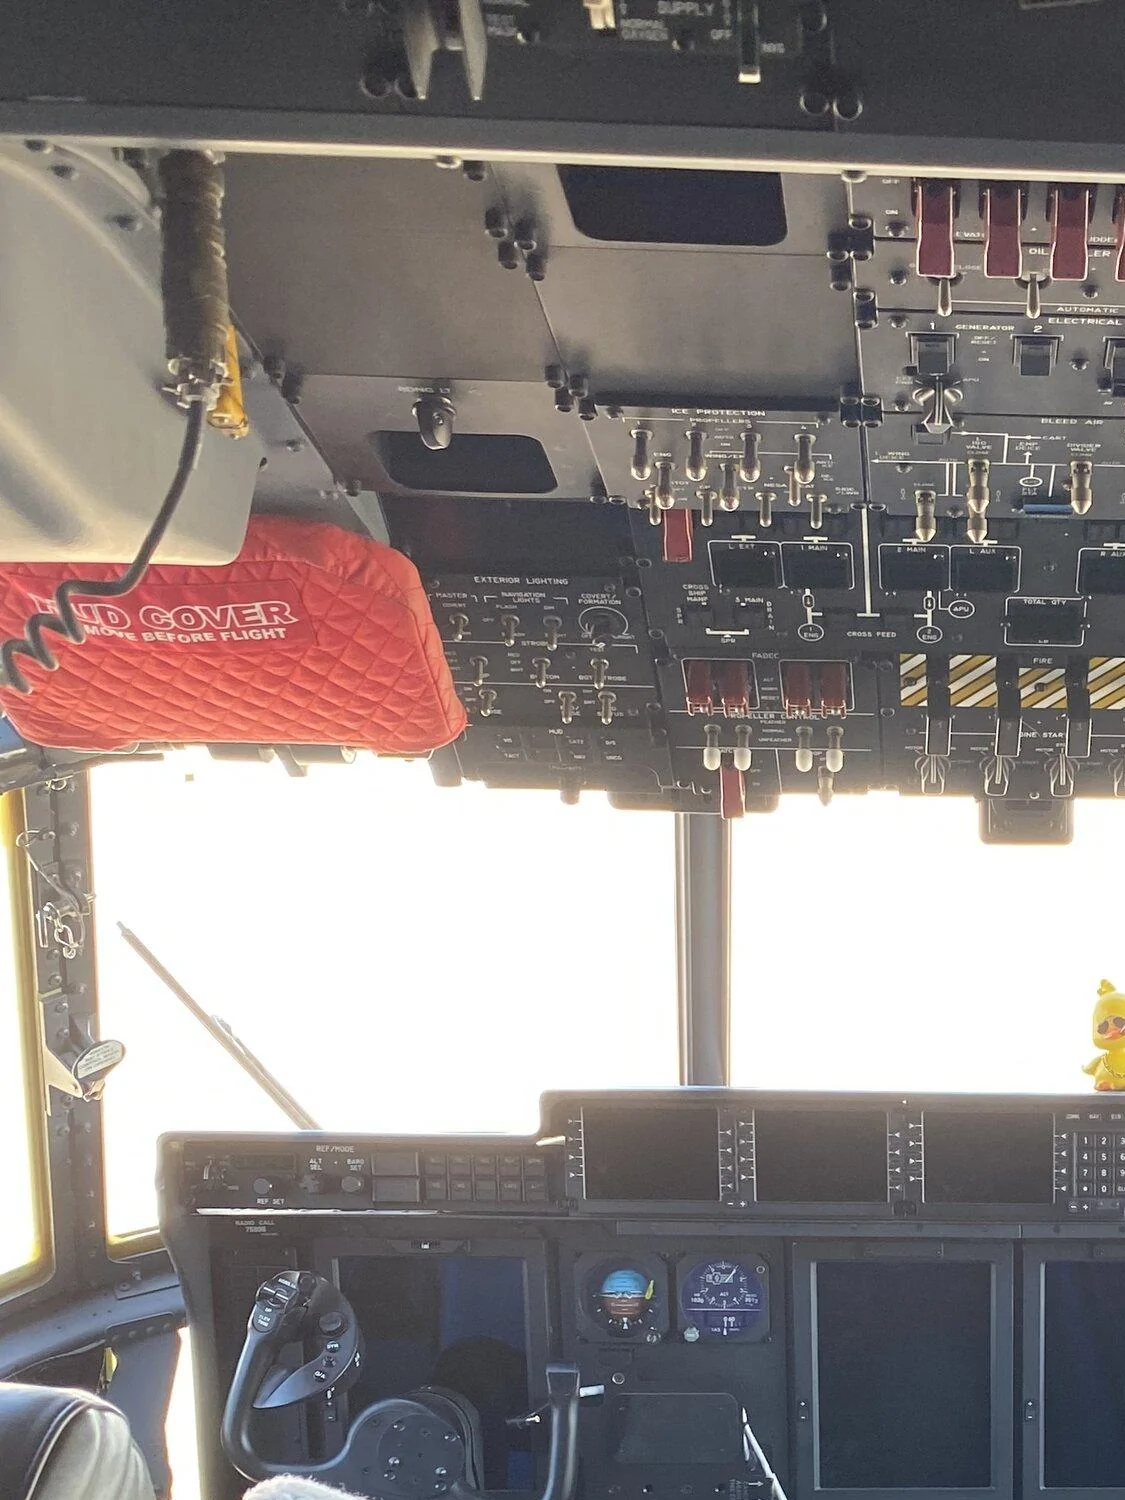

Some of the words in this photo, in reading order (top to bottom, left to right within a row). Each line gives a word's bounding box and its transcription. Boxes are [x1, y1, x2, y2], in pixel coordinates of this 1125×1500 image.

[1056, 306, 1119, 314] AUTOMATIC
[1048, 317, 1123, 326] ELECTRICAL
[1032, 325, 1043, 333] 2
[671, 408, 691, 416] ICE
[696, 408, 766, 417] PROTECTION
[689, 417, 751, 425] PROPELLERS
[473, 576, 521, 584] EXTERIOR
[526, 577, 569, 586] LIGHTING
[139, 600, 300, 631] COVER
[83, 624, 138, 642] MOVE
[141, 630, 217, 644] BEFORE
[219, 627, 287, 643] FLIGHT
[315, 1145, 354, 1153] REF/MODE
